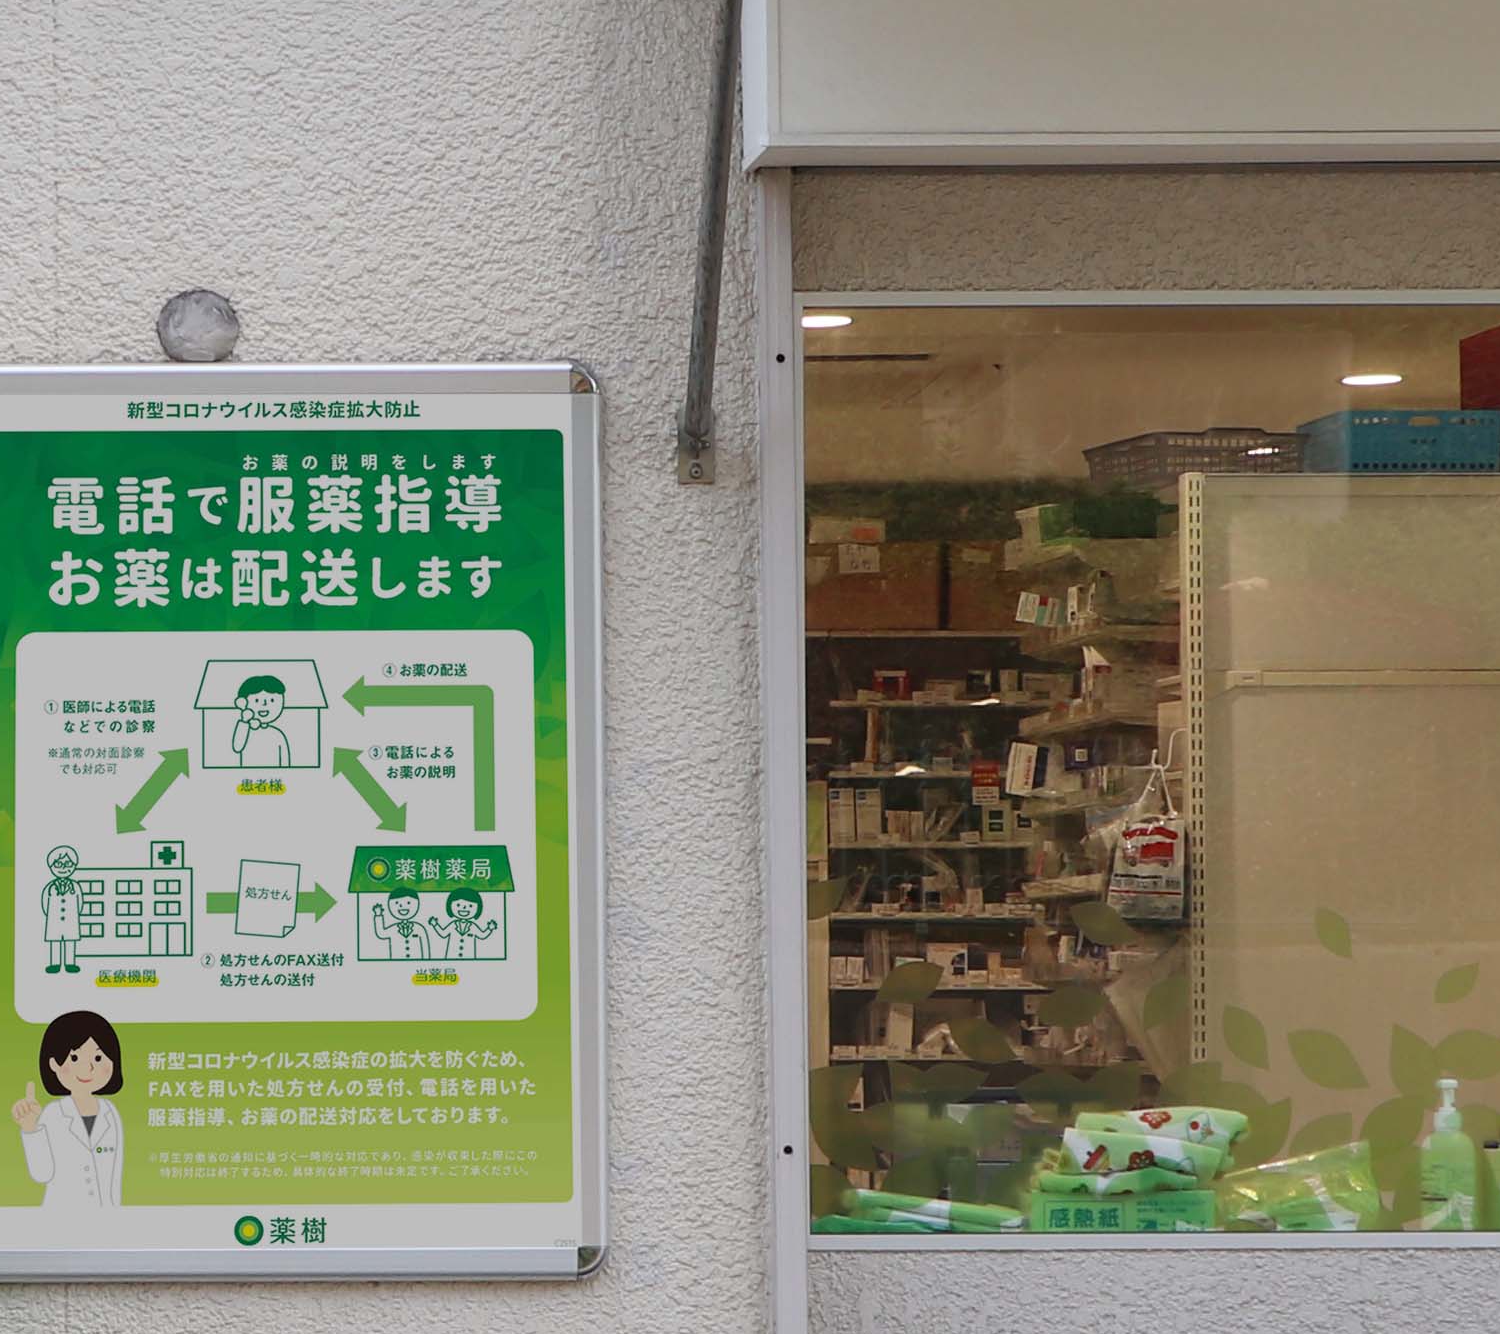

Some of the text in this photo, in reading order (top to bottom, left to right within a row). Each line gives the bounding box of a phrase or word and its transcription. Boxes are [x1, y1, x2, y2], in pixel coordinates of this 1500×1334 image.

[126, 399, 421, 421] 新型コロナウイルス感染症拡大防止
[242, 453, 497, 471] お薬の説明をします
[46, 475, 502, 536] 電話で服薬指導
[48, 548, 503, 608] お薬は配送します
[399, 663, 468, 678] お薬の配送
[62, 699, 156, 714] 医師による電話
[64, 720, 156, 734] などでの診察
[385, 746, 455, 760] 電話による
[386, 765, 457, 780] お薬の説明
[394, 858, 492, 881] 薬樹薬局
[244, 886, 292, 901] 処方せん
[219, 953, 345, 967] 処方せんのFAX送付
[219, 973, 315, 987] 処方せんの送付
[147, 1049, 528, 1071] 新型コロナウイルス感染症の拡大を防ぐため、
[147, 1077, 538, 1099] FAXを用いた処方せんの受付、電話を用いた
[147, 1105, 511, 1128] 服薬指導、お薬の配送対応をしております。
[1048, 1206, 1121, 1229] 感熱紙
[268, 1215, 328, 1245] 薬樹
